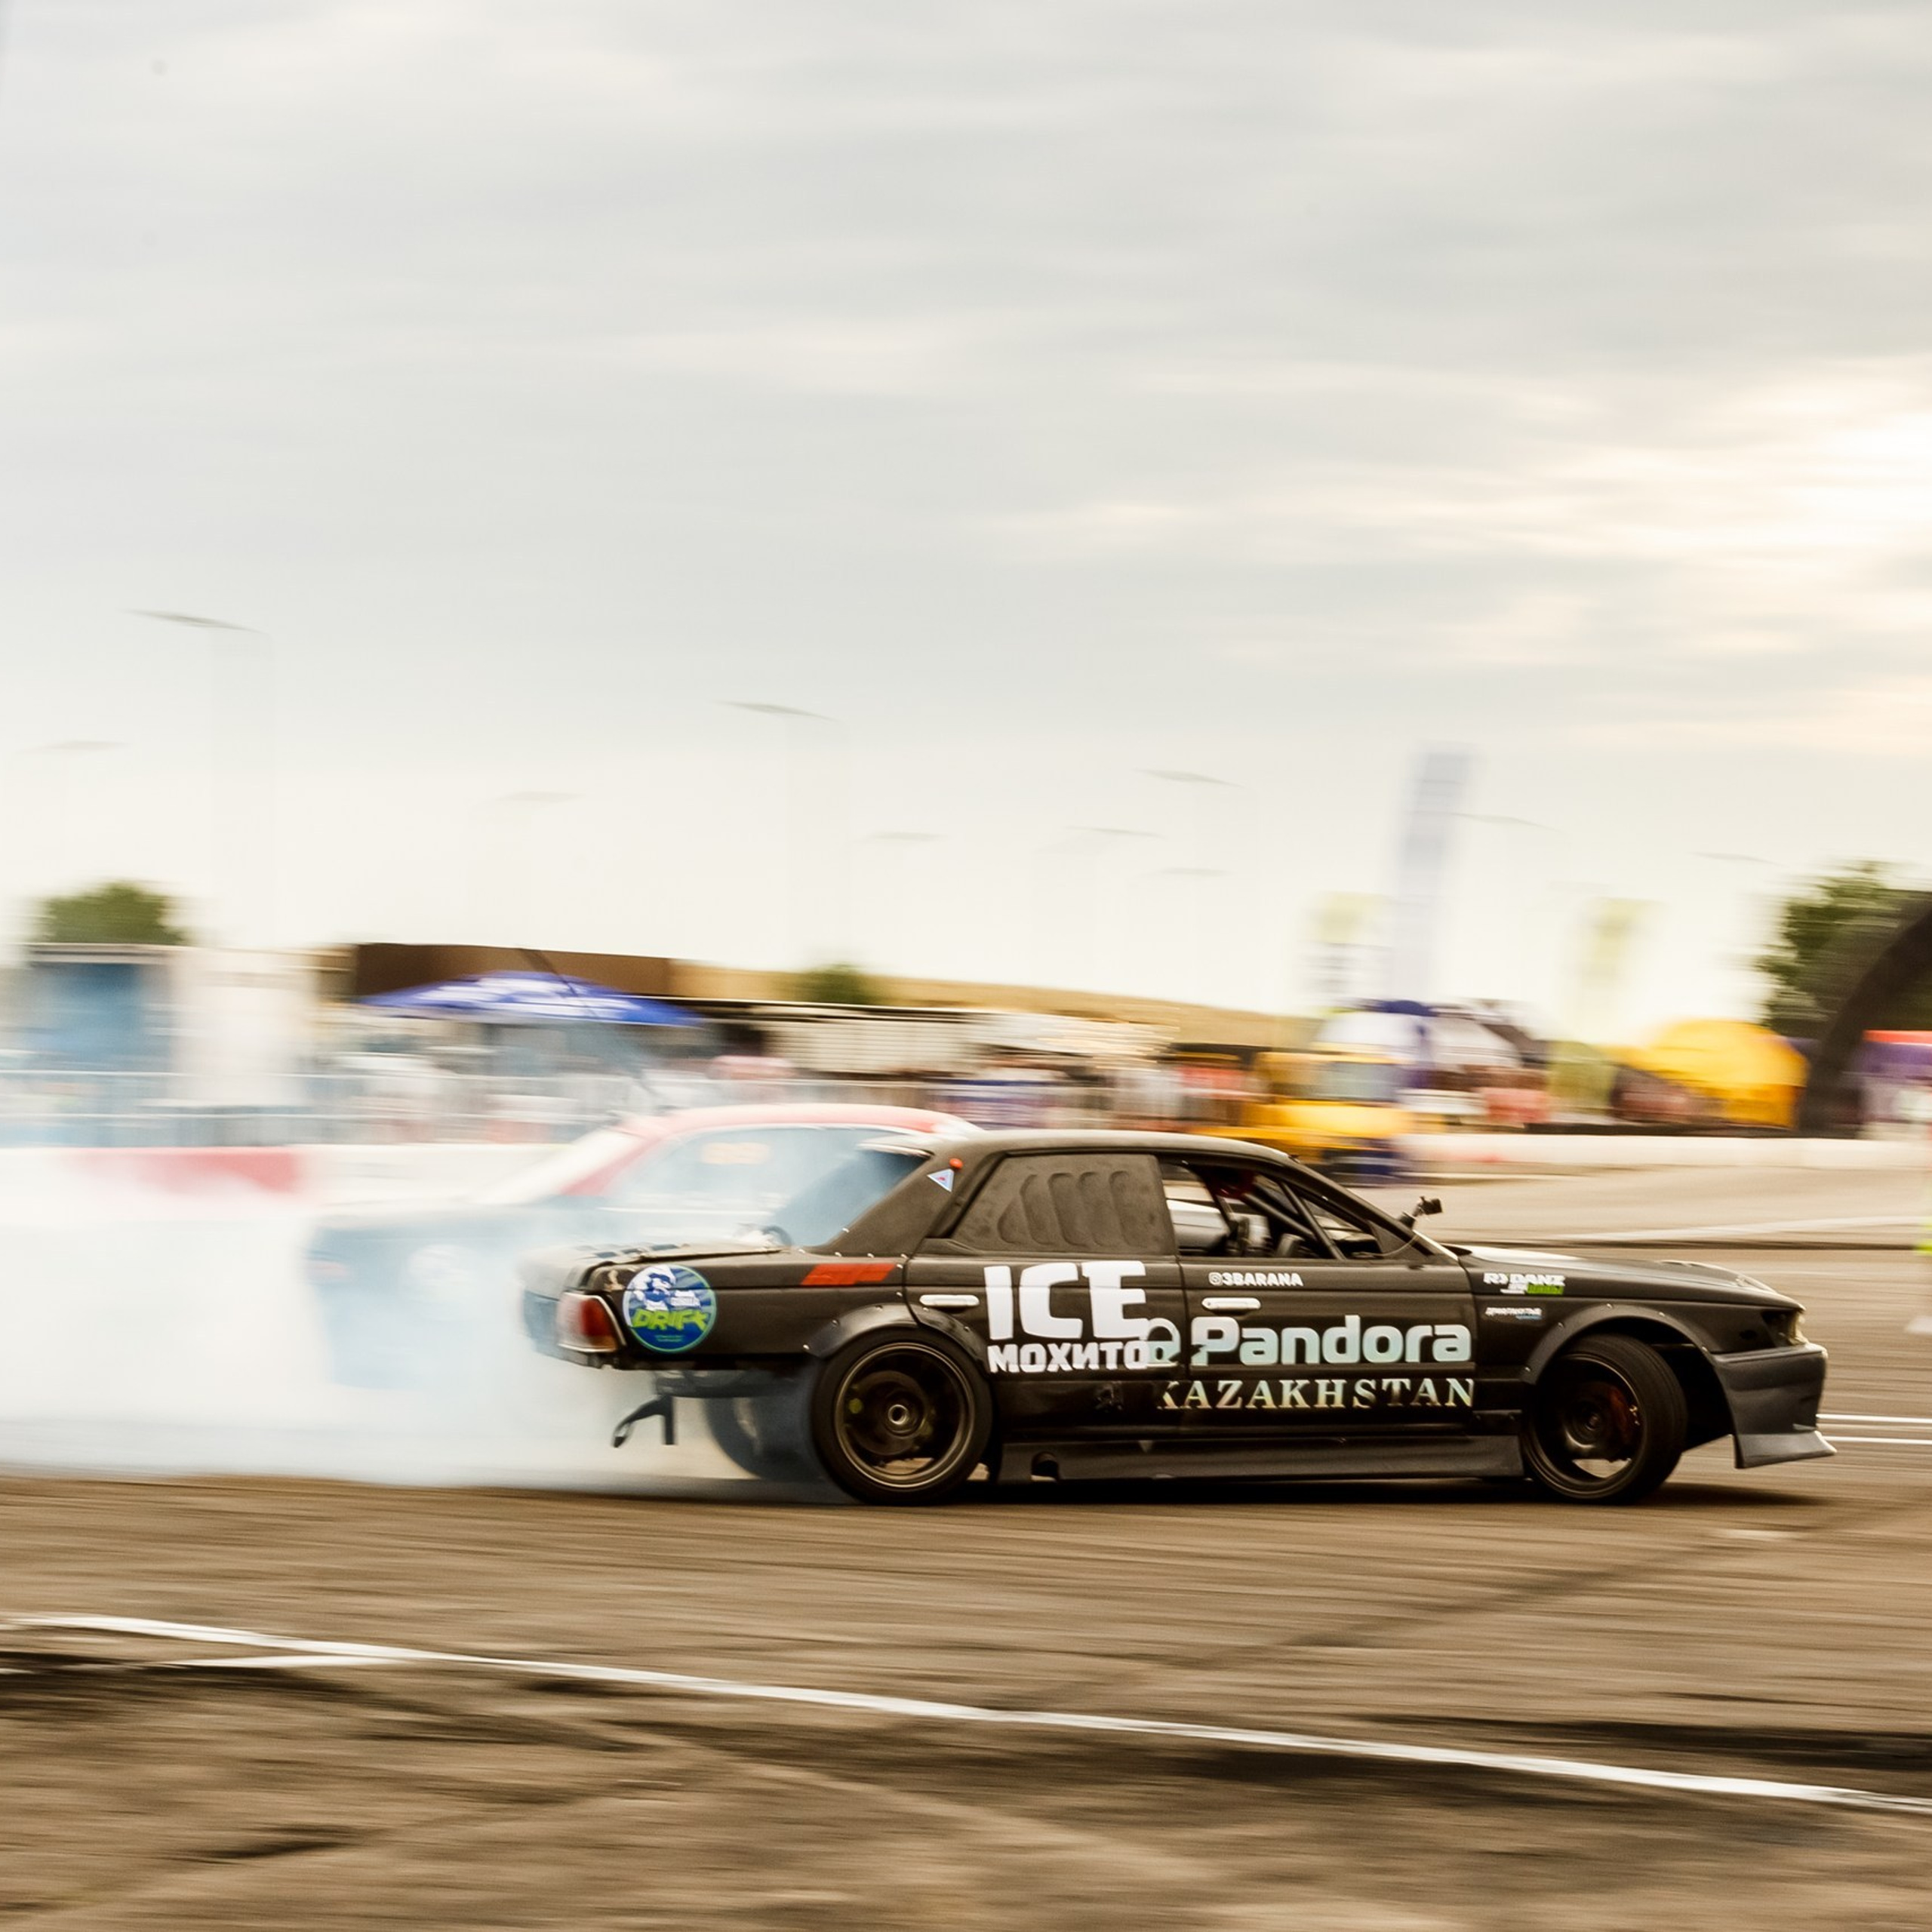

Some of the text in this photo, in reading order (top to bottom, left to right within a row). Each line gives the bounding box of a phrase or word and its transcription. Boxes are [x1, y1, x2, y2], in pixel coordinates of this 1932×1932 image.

[983, 1260, 1149, 1340] ICE
[987, 1340, 1149, 1373] МОХИТО
[1191, 1315, 1472, 1365] Pandora
[1157, 1378, 1474, 1410] KAZAKHSTAN
